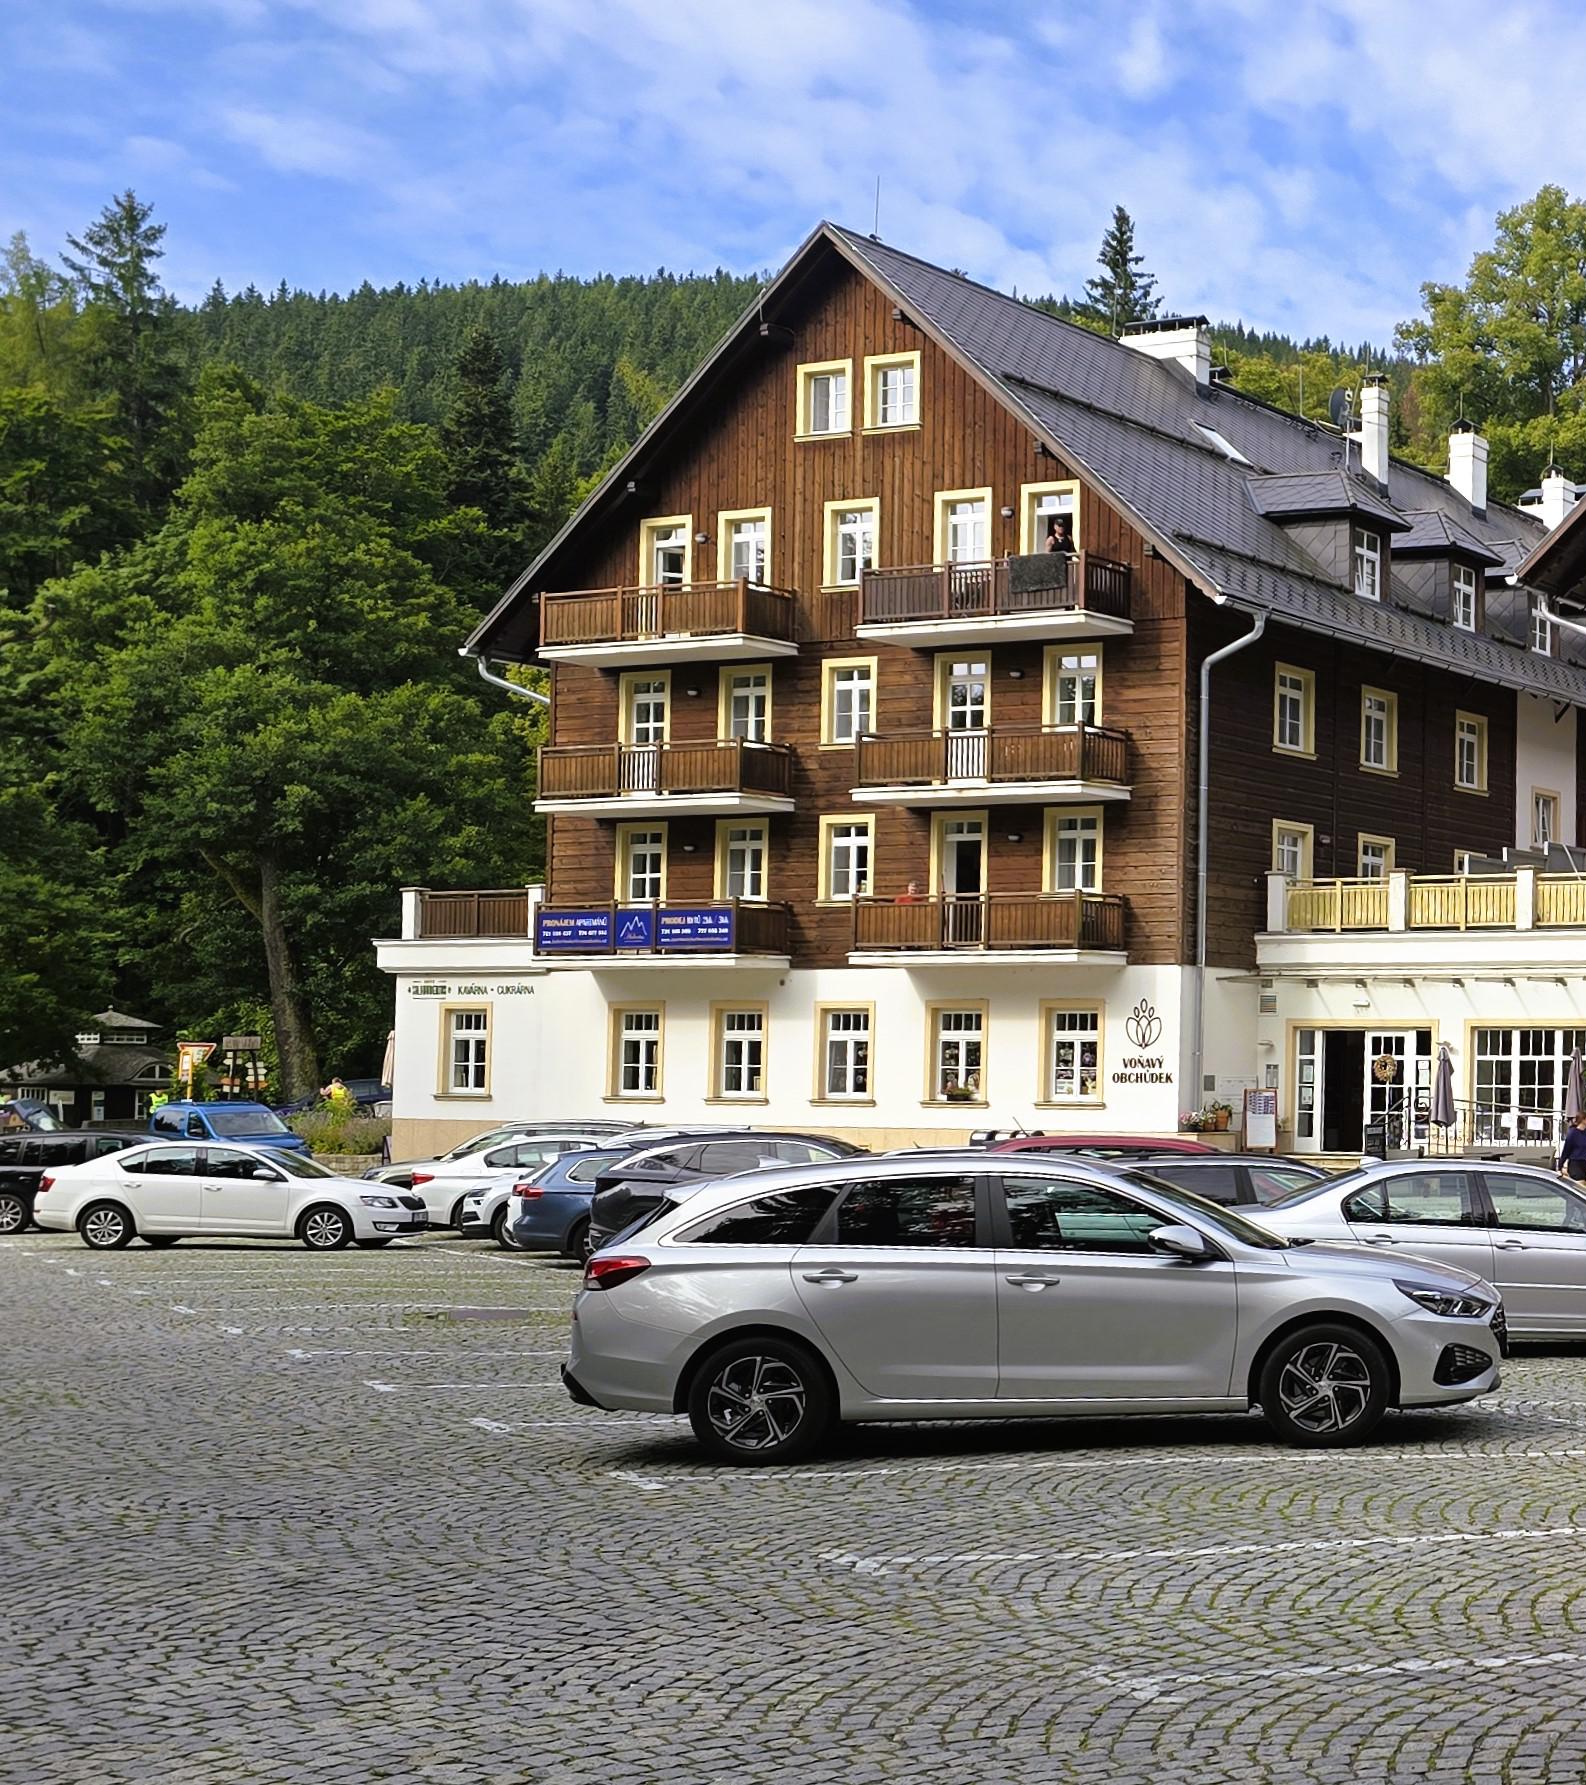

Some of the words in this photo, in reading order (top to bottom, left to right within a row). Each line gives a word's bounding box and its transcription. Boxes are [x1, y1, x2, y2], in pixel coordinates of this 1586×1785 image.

[457, 982, 489, 996] KAVÁRNA
[496, 982, 535, 996] CUKRÁRNA
[1122, 1055, 1164, 1069] VOŇAVÝ
[1111, 1069, 1174, 1084] OBCHŮDEK
